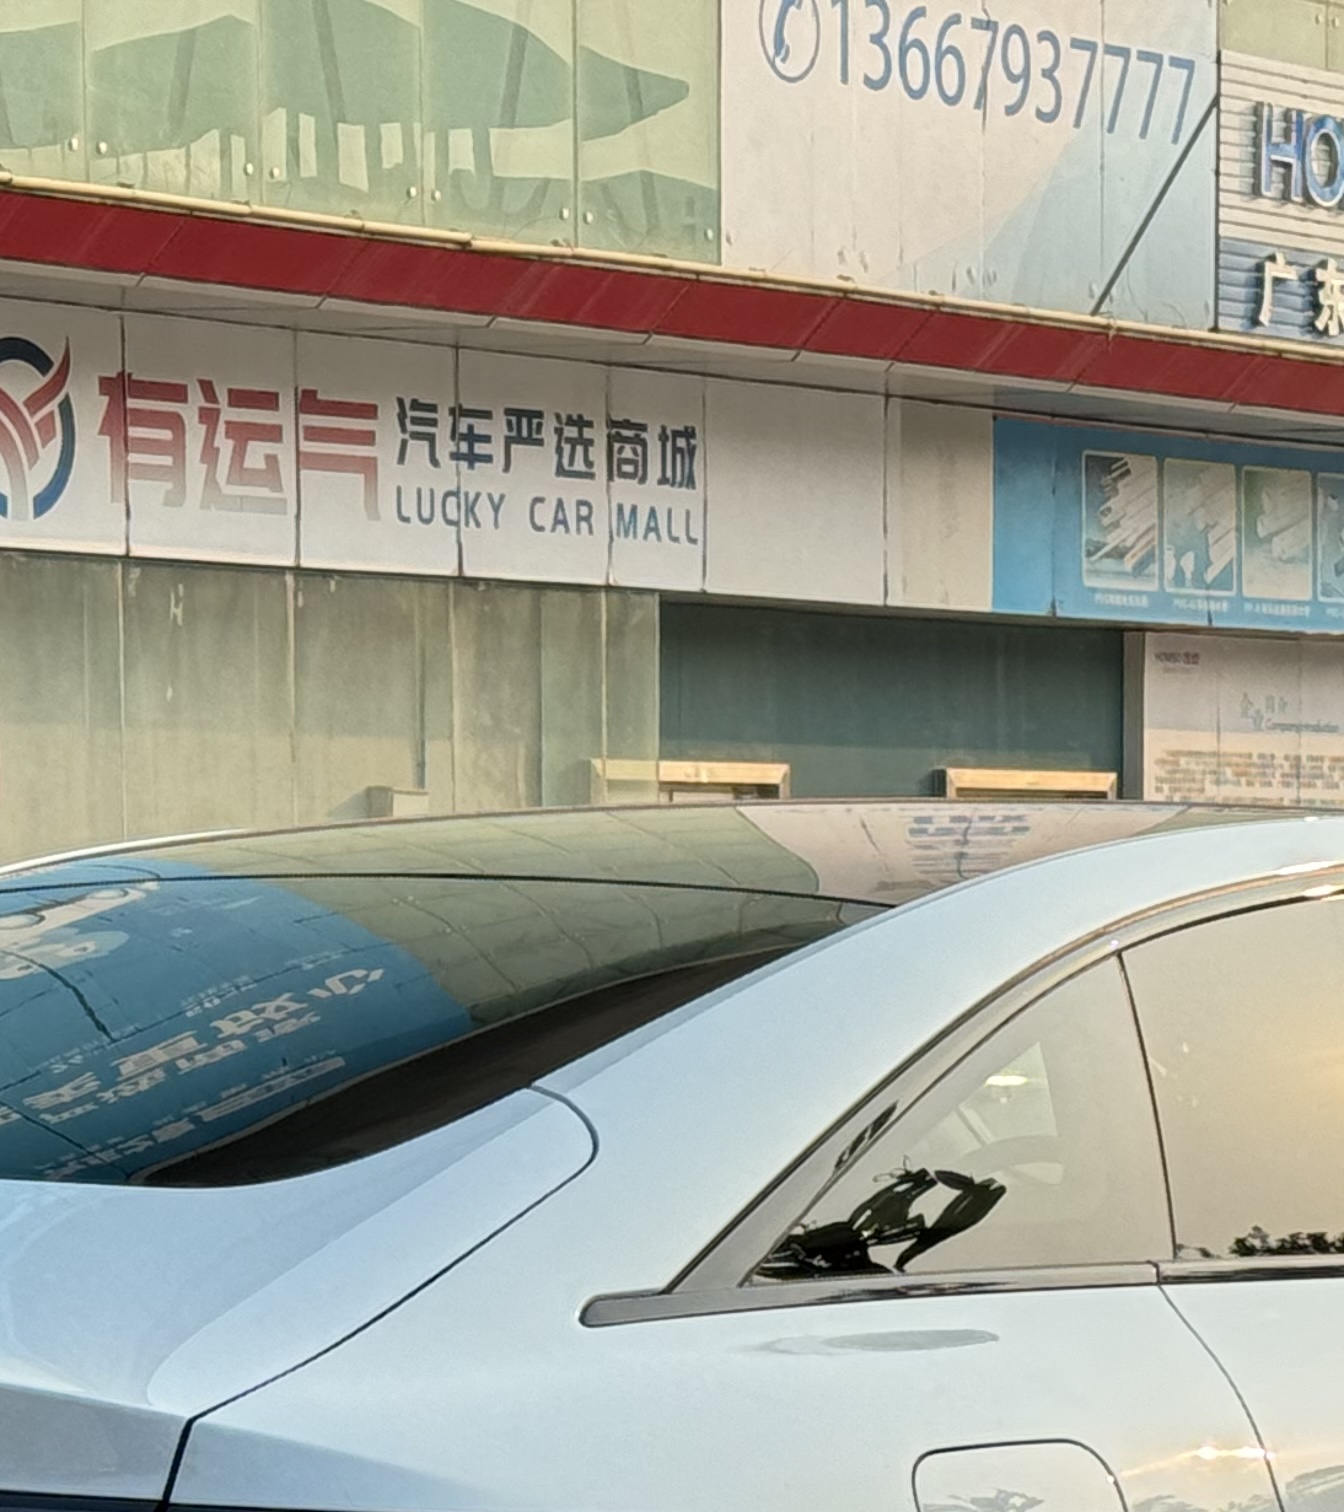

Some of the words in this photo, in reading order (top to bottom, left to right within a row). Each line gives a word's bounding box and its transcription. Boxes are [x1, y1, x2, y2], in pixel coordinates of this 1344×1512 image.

[831, 0, 1195, 145] 13667937777
[97, 370, 380, 521] 有运气
[395, 395, 699, 492] 汽车严选商城
[395, 484, 506, 531] LUCKY
[528, 496, 595, 537] CAR
[615, 504, 699, 547] MALL
